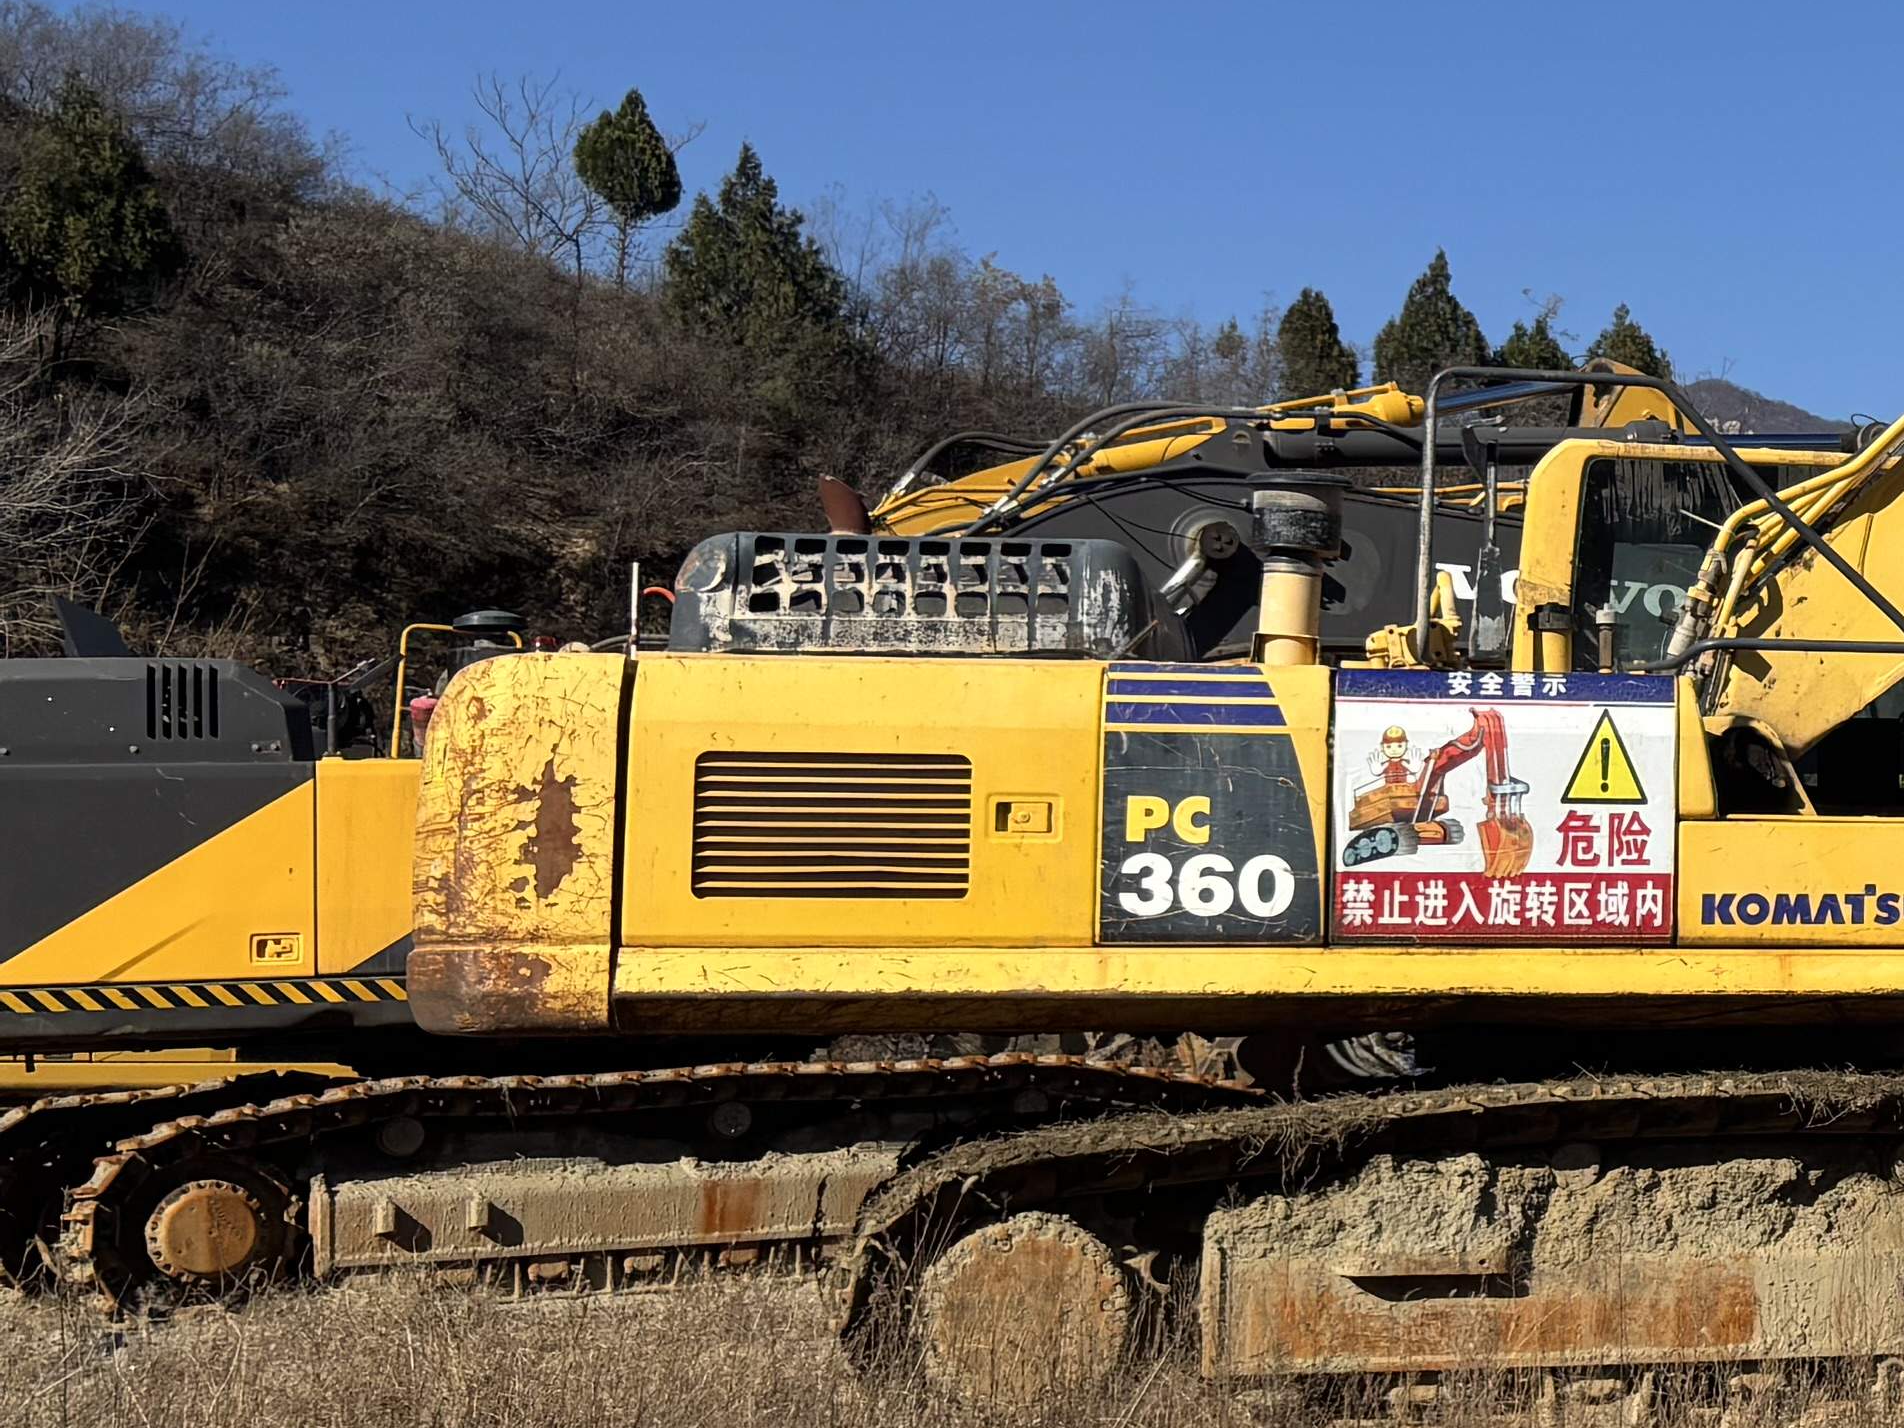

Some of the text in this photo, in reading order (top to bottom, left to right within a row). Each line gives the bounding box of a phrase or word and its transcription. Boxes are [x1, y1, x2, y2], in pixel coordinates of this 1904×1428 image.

[1447, 671, 1568, 697] 安全警示
[1126, 795, 1211, 843] PC
[1556, 810, 1651, 868] 危险
[1118, 853, 1296, 918] 360
[1342, 879, 1664, 927] 禁止进入旋转区域内
